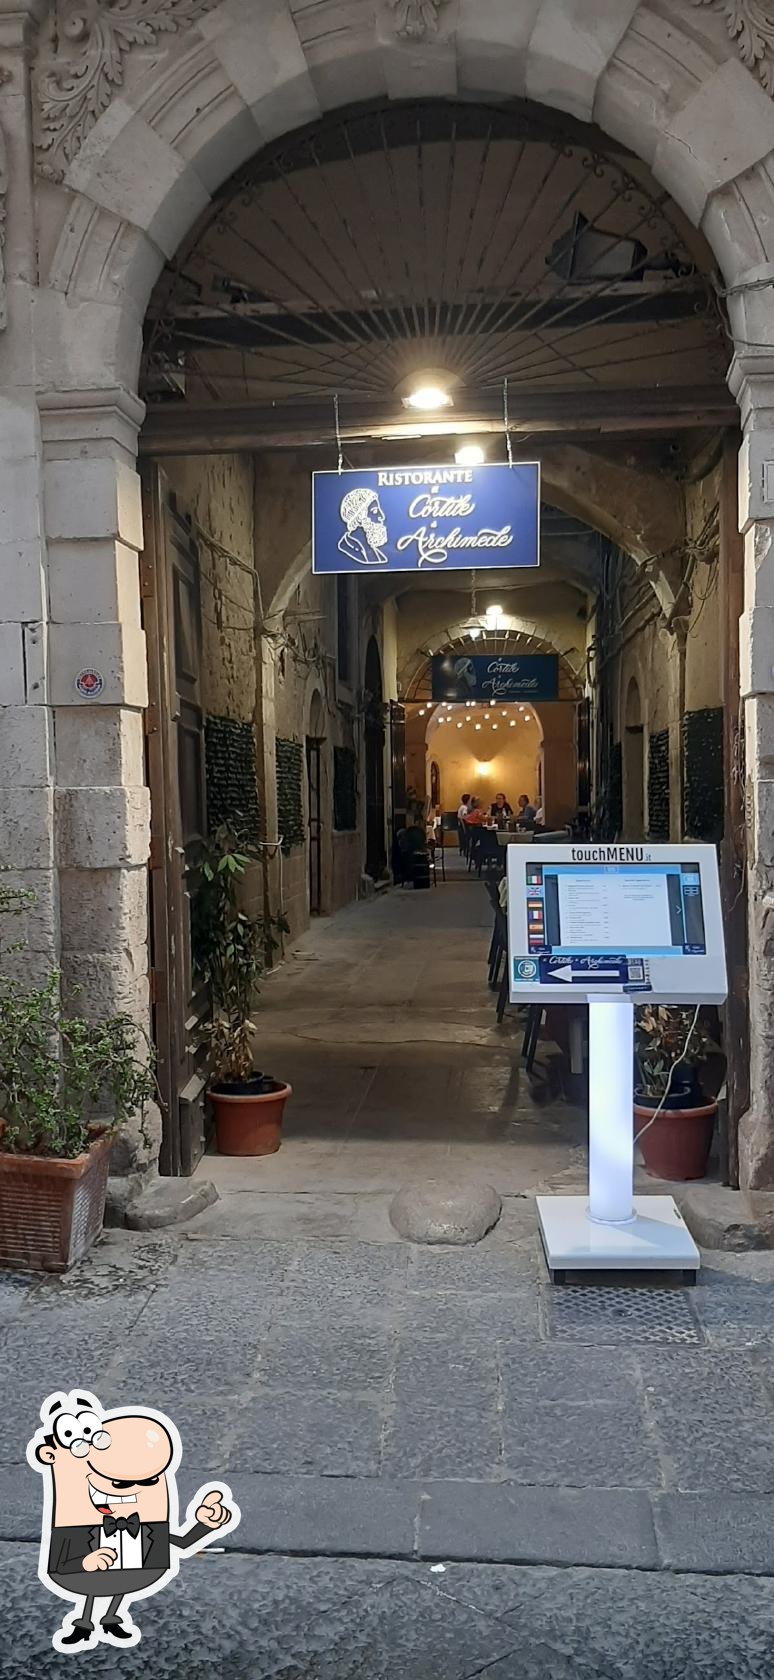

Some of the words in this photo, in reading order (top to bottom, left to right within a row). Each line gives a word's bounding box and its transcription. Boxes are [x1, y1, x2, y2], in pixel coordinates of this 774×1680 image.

[378, 469, 473, 486] RISTORANTE
[409, 494, 475, 518] Cortile
[397, 525, 514, 567] Archimede
